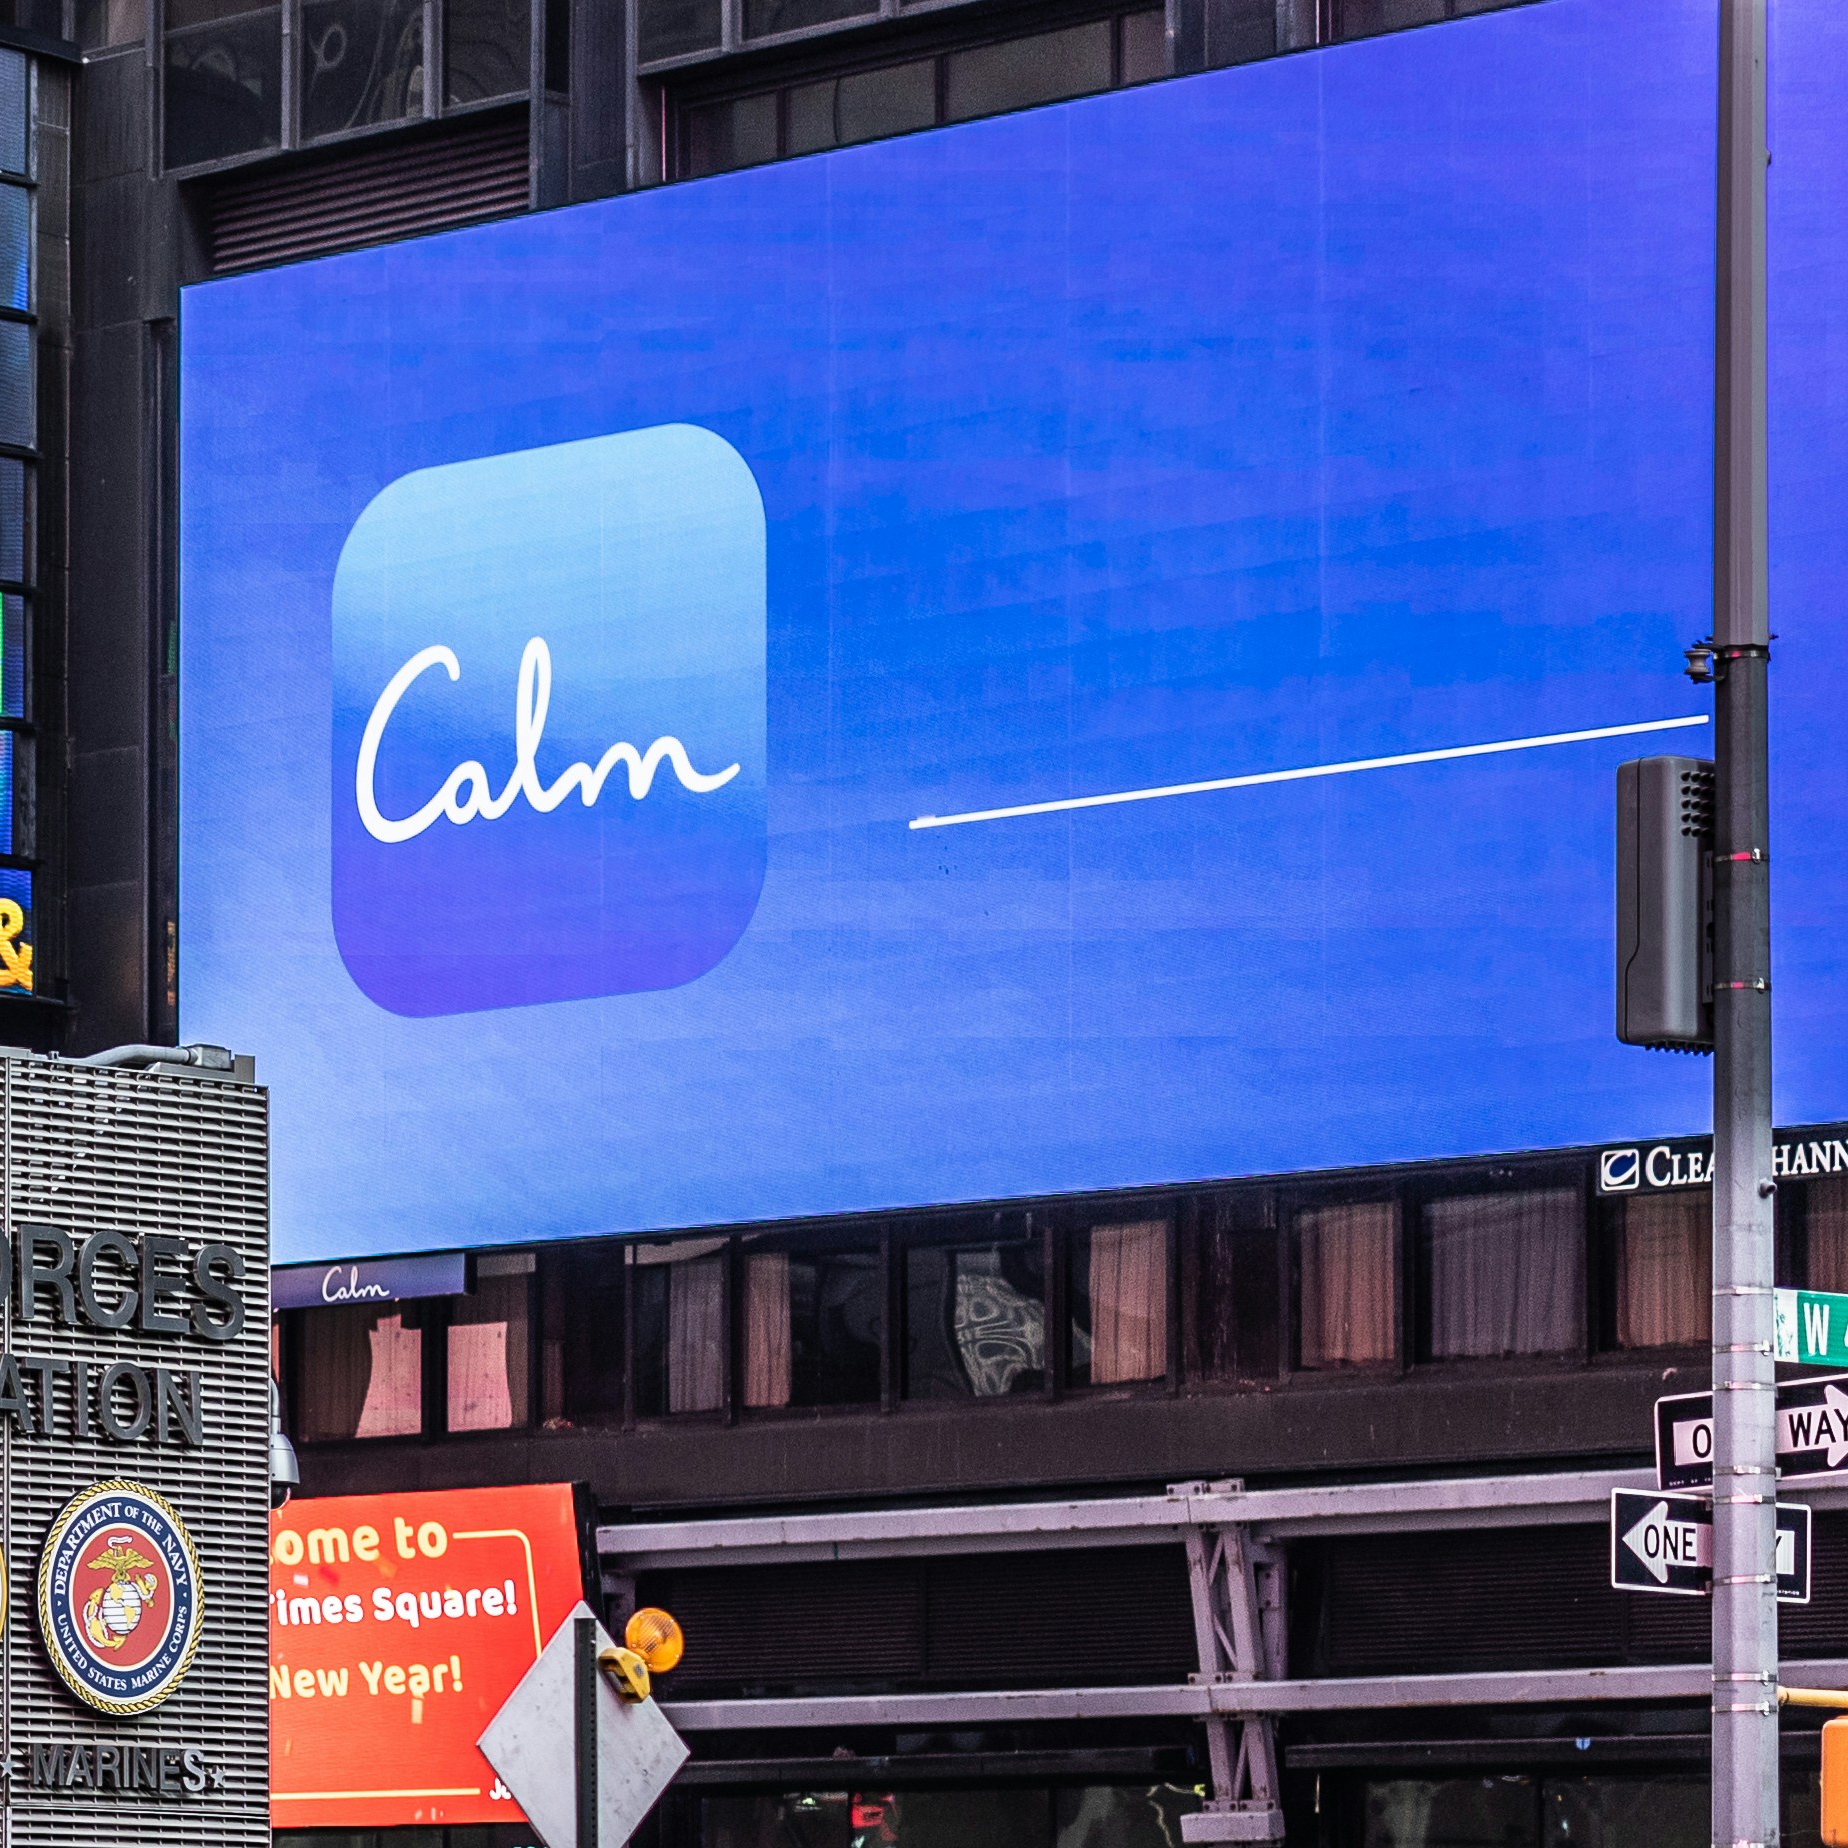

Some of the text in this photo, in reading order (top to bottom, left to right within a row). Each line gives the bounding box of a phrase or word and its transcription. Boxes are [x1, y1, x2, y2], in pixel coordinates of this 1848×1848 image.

[356, 636, 740, 844] Calm
[322, 1265, 390, 1302] Calm
[1803, 1302, 1830, 1356] W
[54, 1501, 188, 1596] DEPARTMENT OF THE NAVY
[394, 1517, 448, 1560] to
[1643, 1523, 1697, 1563] ONE
[270, 1579, 518, 1628] imes Square!
[56, 1605, 189, 1691] UNITED STATES MARINE CORPS
[270, 1655, 463, 1699] New Year!
[31, 1743, 206, 1792] MARINES
